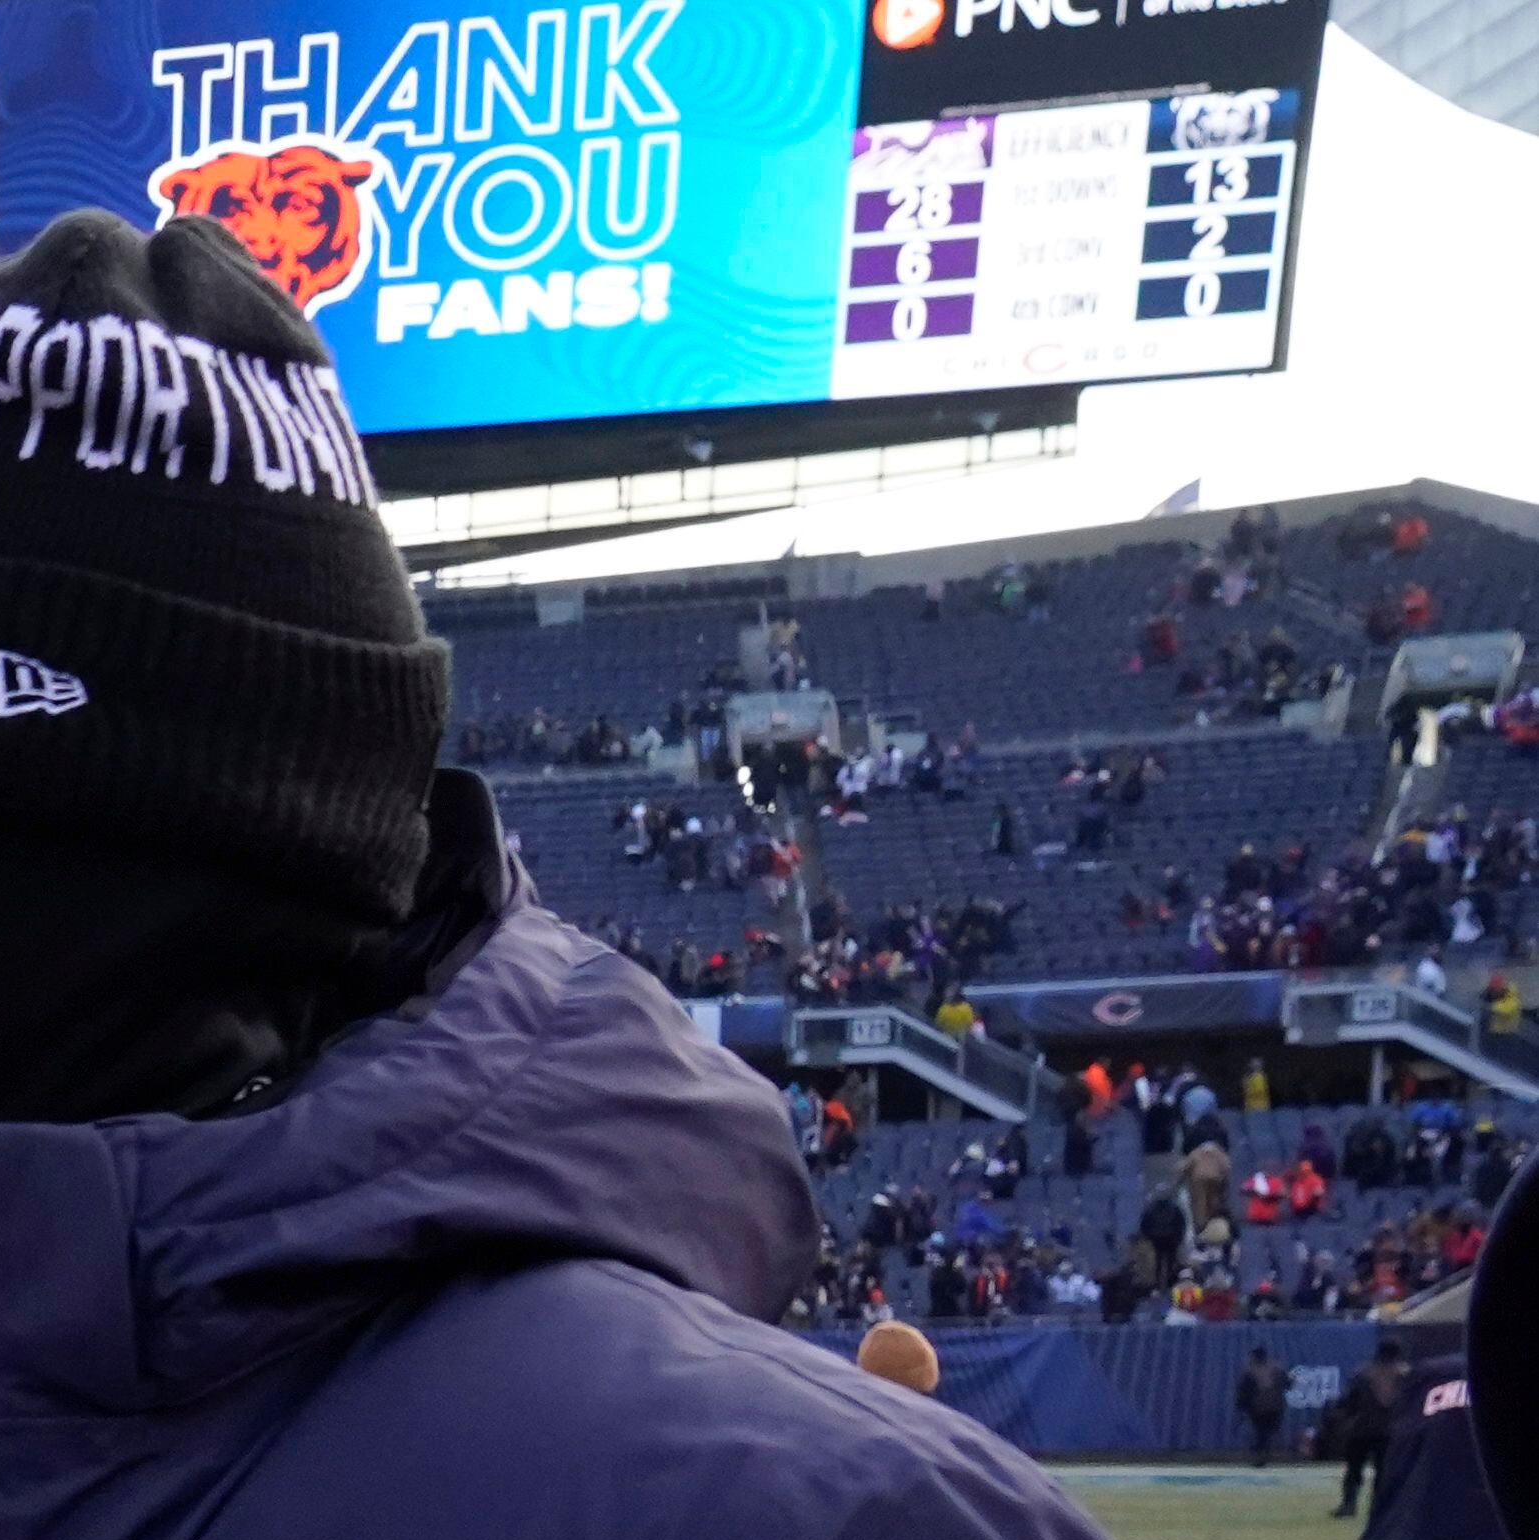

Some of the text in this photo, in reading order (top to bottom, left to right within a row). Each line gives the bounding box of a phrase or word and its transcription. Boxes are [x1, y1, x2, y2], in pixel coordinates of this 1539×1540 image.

[152, 0, 689, 165] THANK
[368, 131, 681, 278] YOU
[884, 183, 952, 231] 28
[1184, 155, 1250, 204] 13
[895, 240, 932, 284] 6
[1189, 215, 1229, 261] 2
[376, 262, 672, 343] FANS!
[891, 297, 928, 342] 0
[1183, 271, 1221, 318] 0
